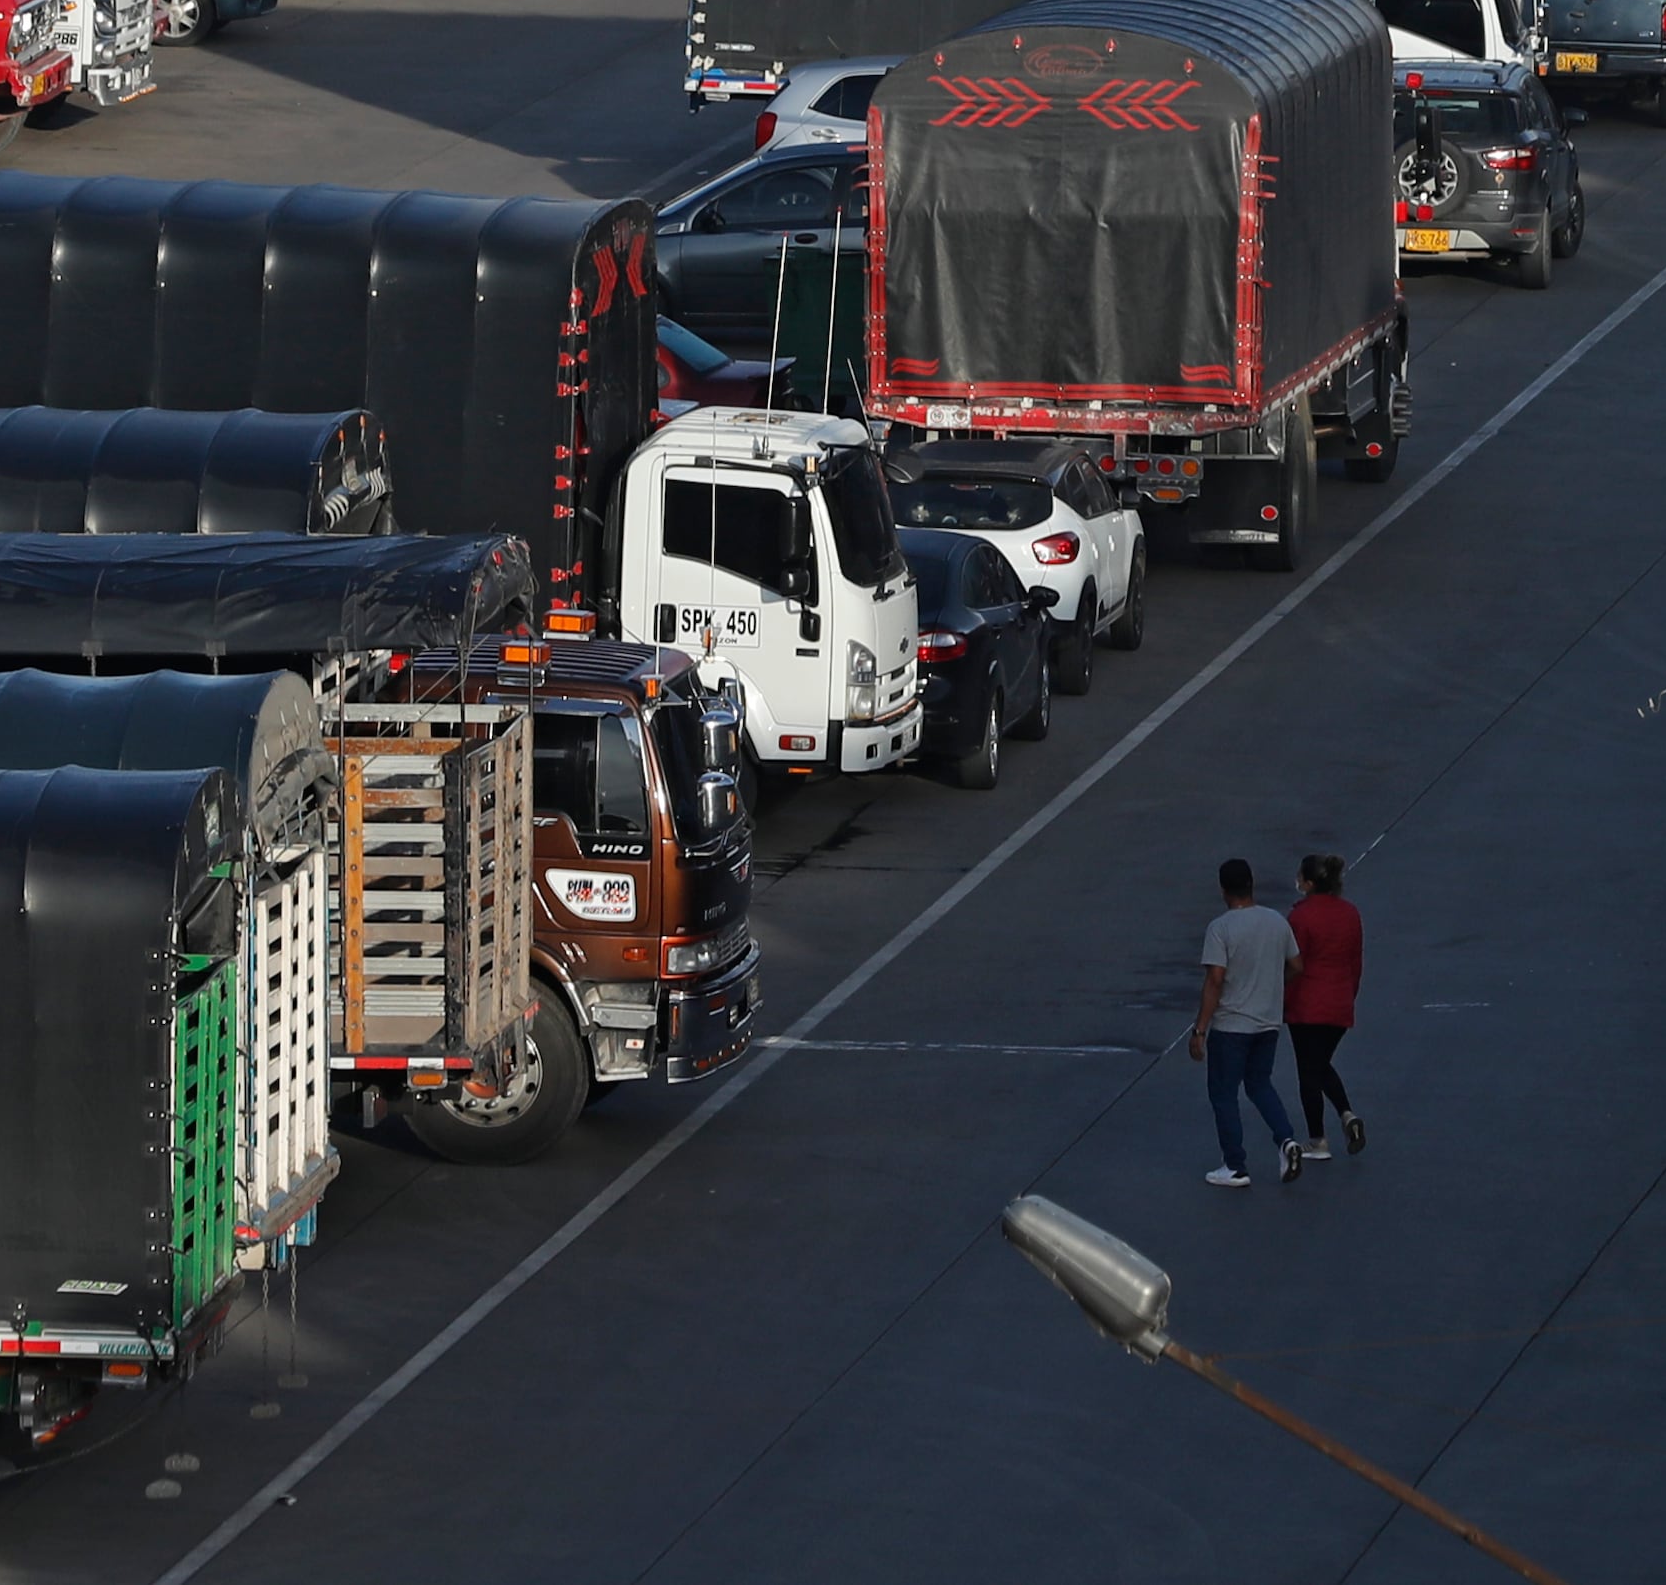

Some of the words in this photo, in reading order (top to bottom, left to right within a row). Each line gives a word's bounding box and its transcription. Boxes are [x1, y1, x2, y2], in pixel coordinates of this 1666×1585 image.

[681, 608, 715, 632] SPK
[726, 611, 758, 636] 450
[591, 844, 644, 855] HINO
